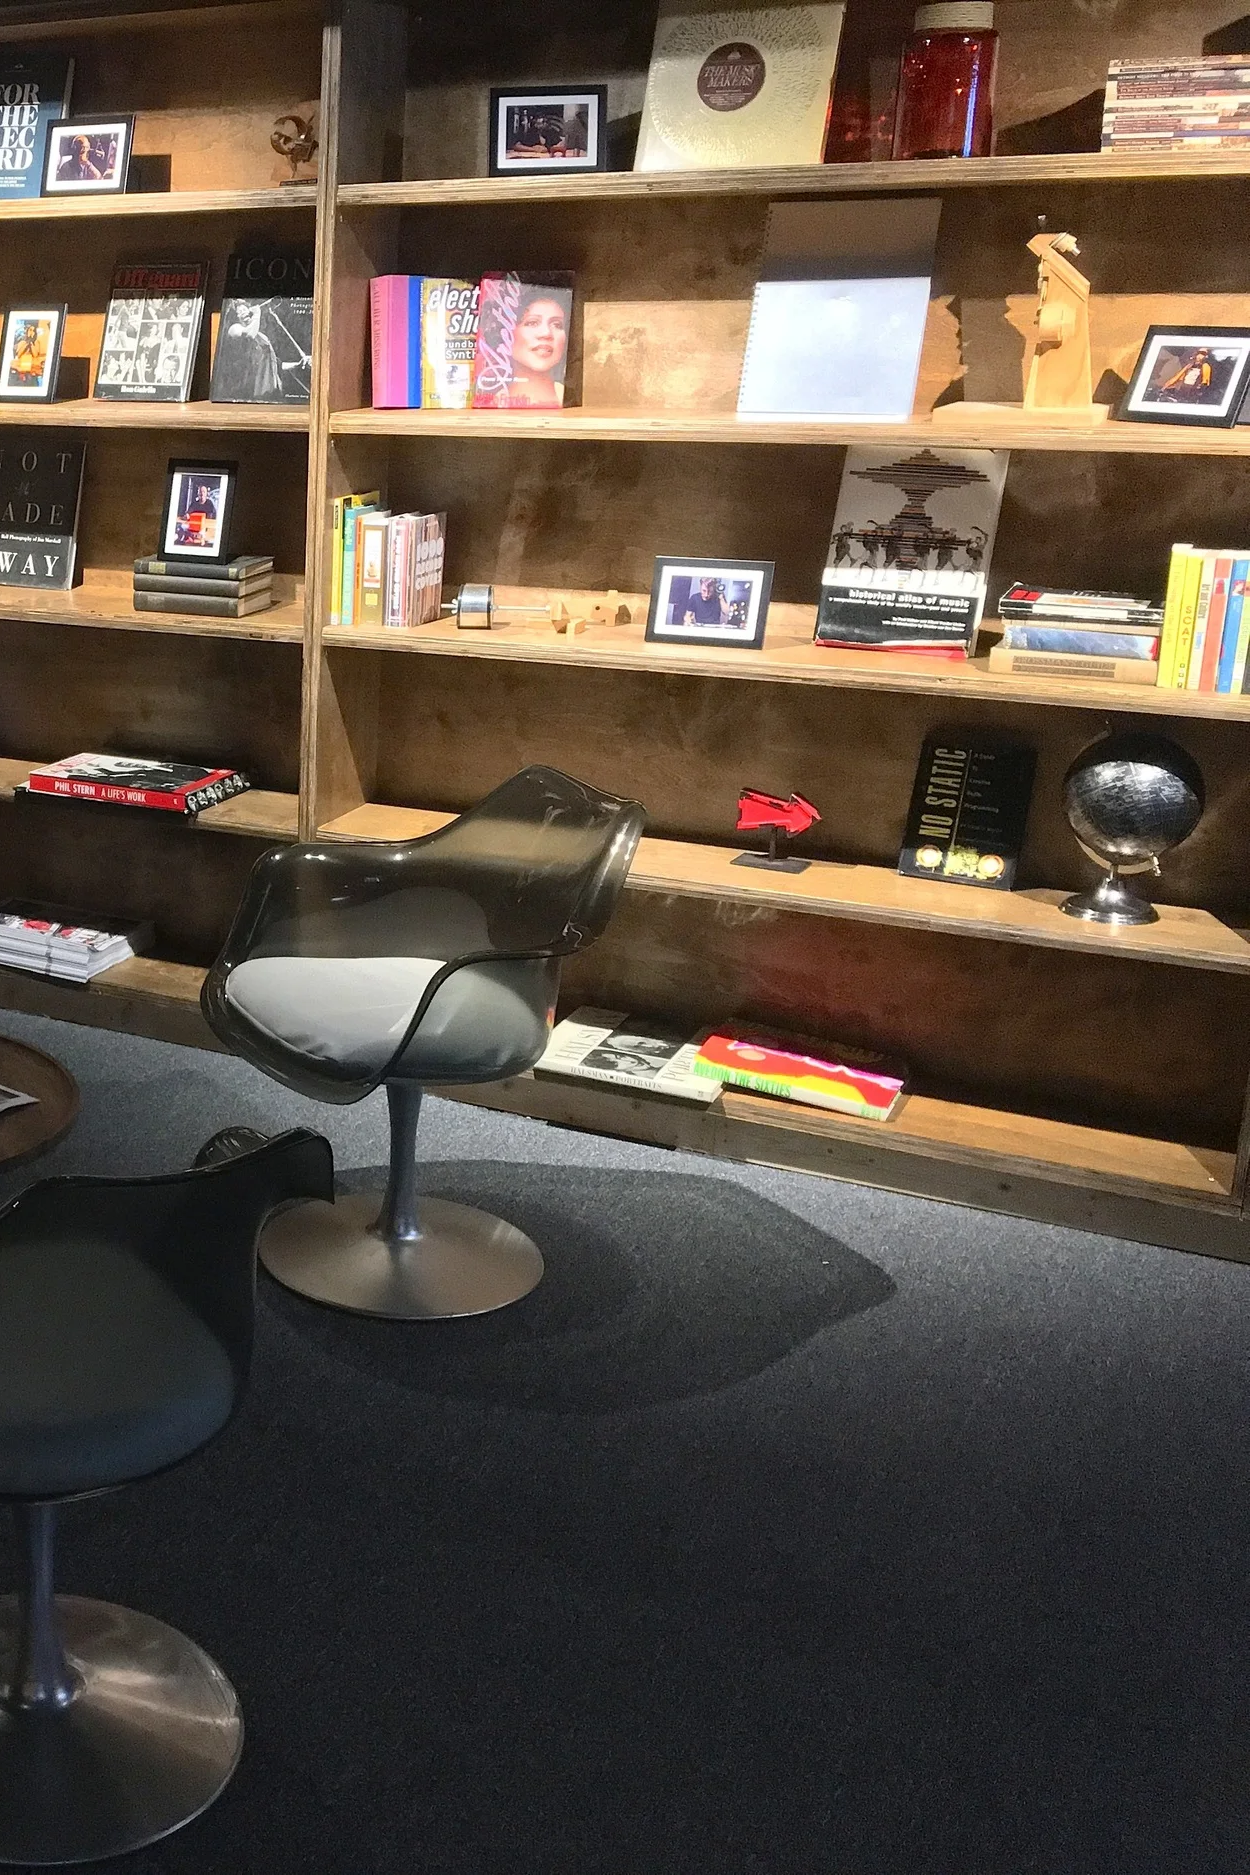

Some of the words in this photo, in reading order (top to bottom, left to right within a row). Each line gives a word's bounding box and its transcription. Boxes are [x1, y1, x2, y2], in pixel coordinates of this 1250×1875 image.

[234, 257, 313, 281] ICON
[428, 283, 480, 311] elect
[849, 588, 896, 602] historical
[898, 593, 923, 604] atlas
[925, 596, 937, 605] of
[939, 597, 970, 608] music
[1181, 605, 1193, 646] SCAT
[924, 748, 967, 808] STATIC
[54, 780, 71, 793] PHIL
[72, 783, 96, 796] STERN
[100, 787, 106, 797] A
[107, 787, 126, 800] LIFE'S
[127, 790, 146, 803] WORK
[918, 814, 953, 838] NO
[570, 1065, 609, 1080] HALSMAN
[614, 1075, 663, 1091] PORTRAITS
[694, 1061, 731, 1082] AVEDON
[734, 1070, 751, 1089] THE
[754, 1076, 792, 1098] SIXTIES
